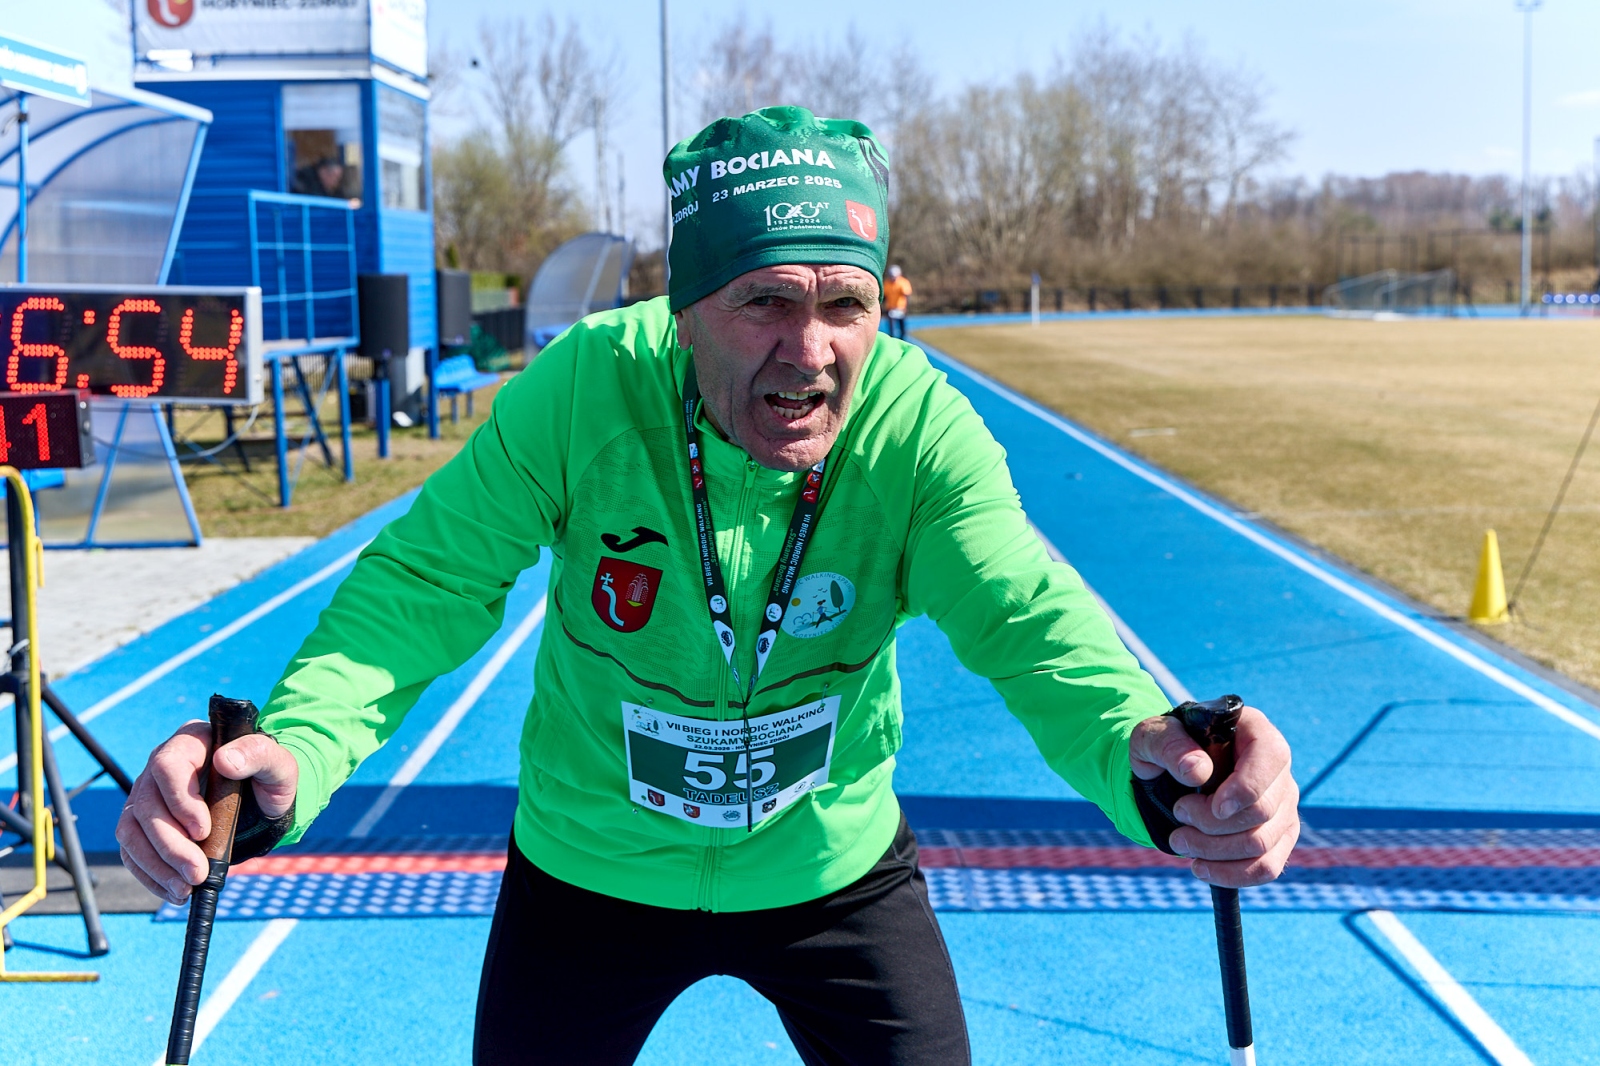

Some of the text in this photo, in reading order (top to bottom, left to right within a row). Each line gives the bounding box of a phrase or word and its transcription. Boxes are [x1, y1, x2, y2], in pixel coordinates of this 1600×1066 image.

[710, 148, 836, 180] BOCIANA
[712, 175, 842, 203] 23 MARZEC 2025
[696, 503, 705, 532] WALKING
[798, 522, 809, 538] BIEG
[700, 532, 709, 558] NORDIC
[790, 541, 804, 566] NORDIC
[704, 560, 712, 577] BIEG
[781, 565, 796, 594] WALKING
[804, 573, 836, 581] WALKING
[706, 576, 714, 587] VII
[666, 720, 681, 731] VII
[682, 724, 711, 736] BIEG
[715, 729, 718, 737] I
[721, 723, 769, 737] NORDIC
[772, 706, 825, 729] WALKING
[686, 723, 803, 746] SZUKAMY BOCIANA
[735, 740, 769, 750] HOYNIEC
[683, 747, 777, 791] 55
[683, 782, 780, 805] TADEUSZ
